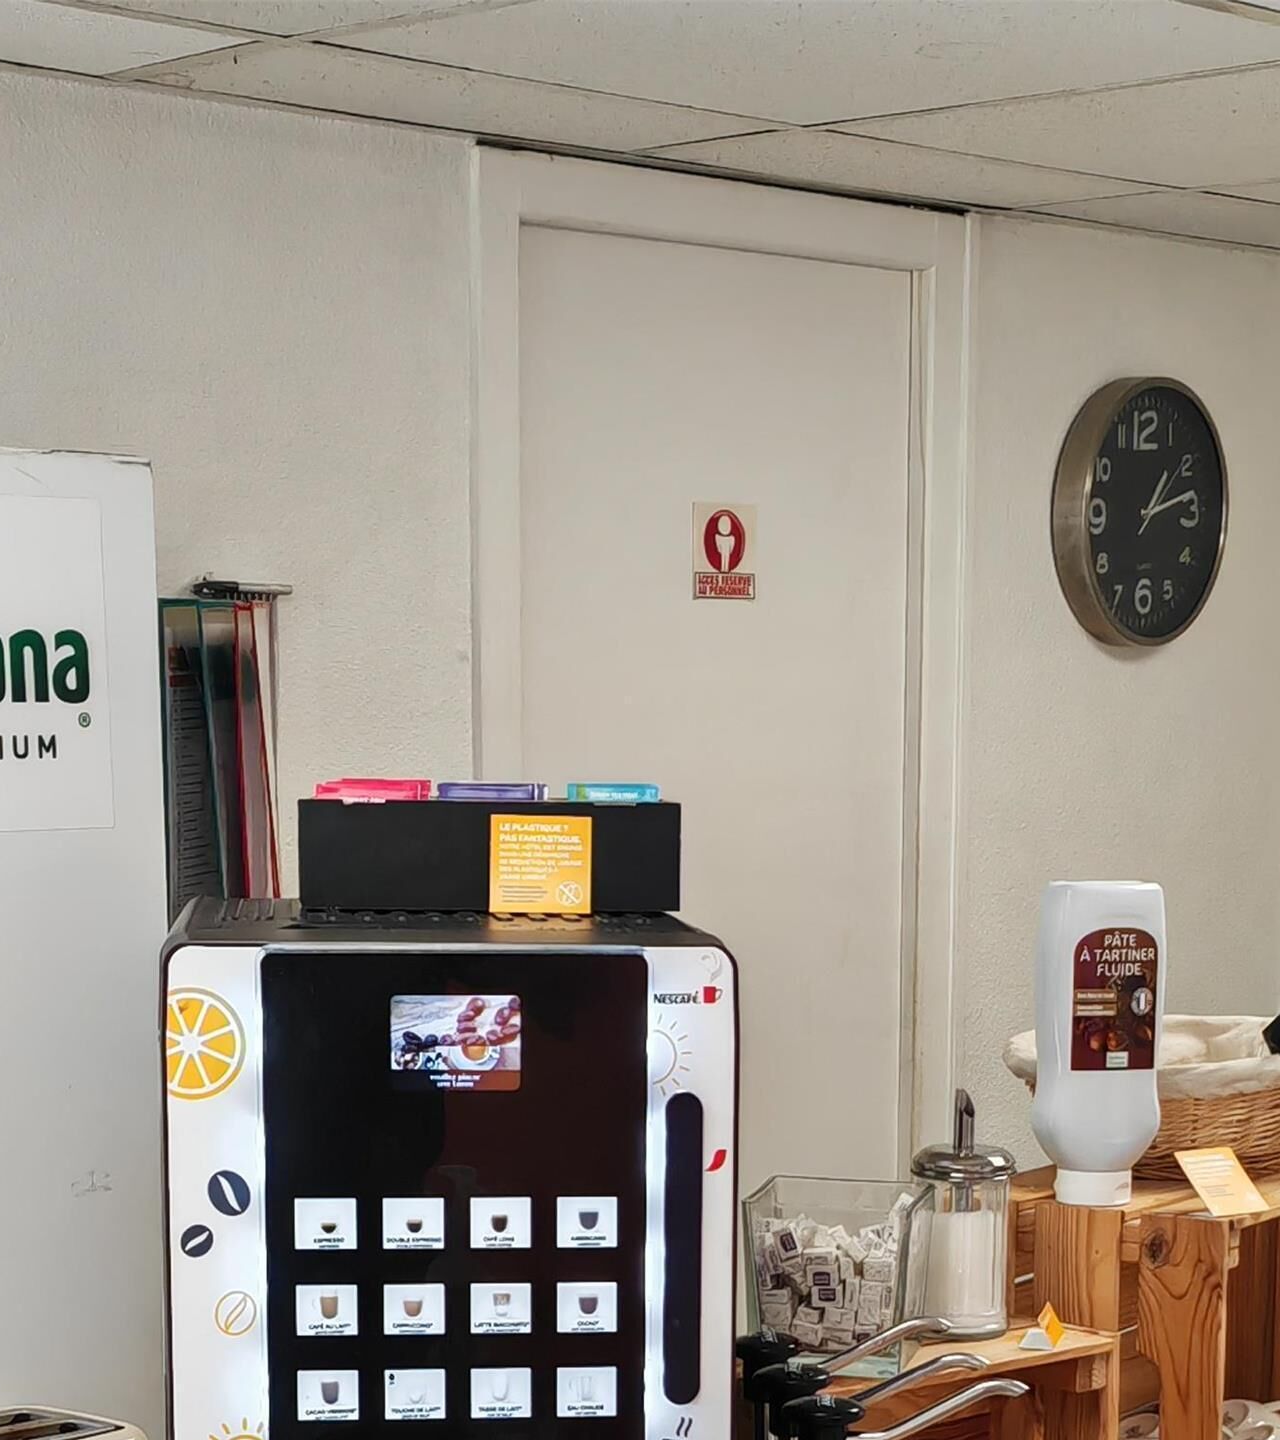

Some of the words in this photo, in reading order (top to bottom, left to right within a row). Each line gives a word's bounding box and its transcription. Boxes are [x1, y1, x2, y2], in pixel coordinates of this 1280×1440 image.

[1133, 410, 1158, 451] 12
[1096, 457, 1112, 482] 10
[1181, 454, 1193, 477] 2
[1089, 497, 1107, 535] 9
[1180, 490, 1199, 528] 3
[1096, 553, 1109, 574] 8
[1179, 547, 1191, 565] 4
[1135, 578, 1152, 614] 6
[1163, 580, 1173, 600] 5
[1104, 931, 1137, 947] PÂTE
[1080, 945, 1091, 962] À
[1094, 948, 1155, 963] TARTINER
[1096, 963, 1144, 977] FLUIDE
